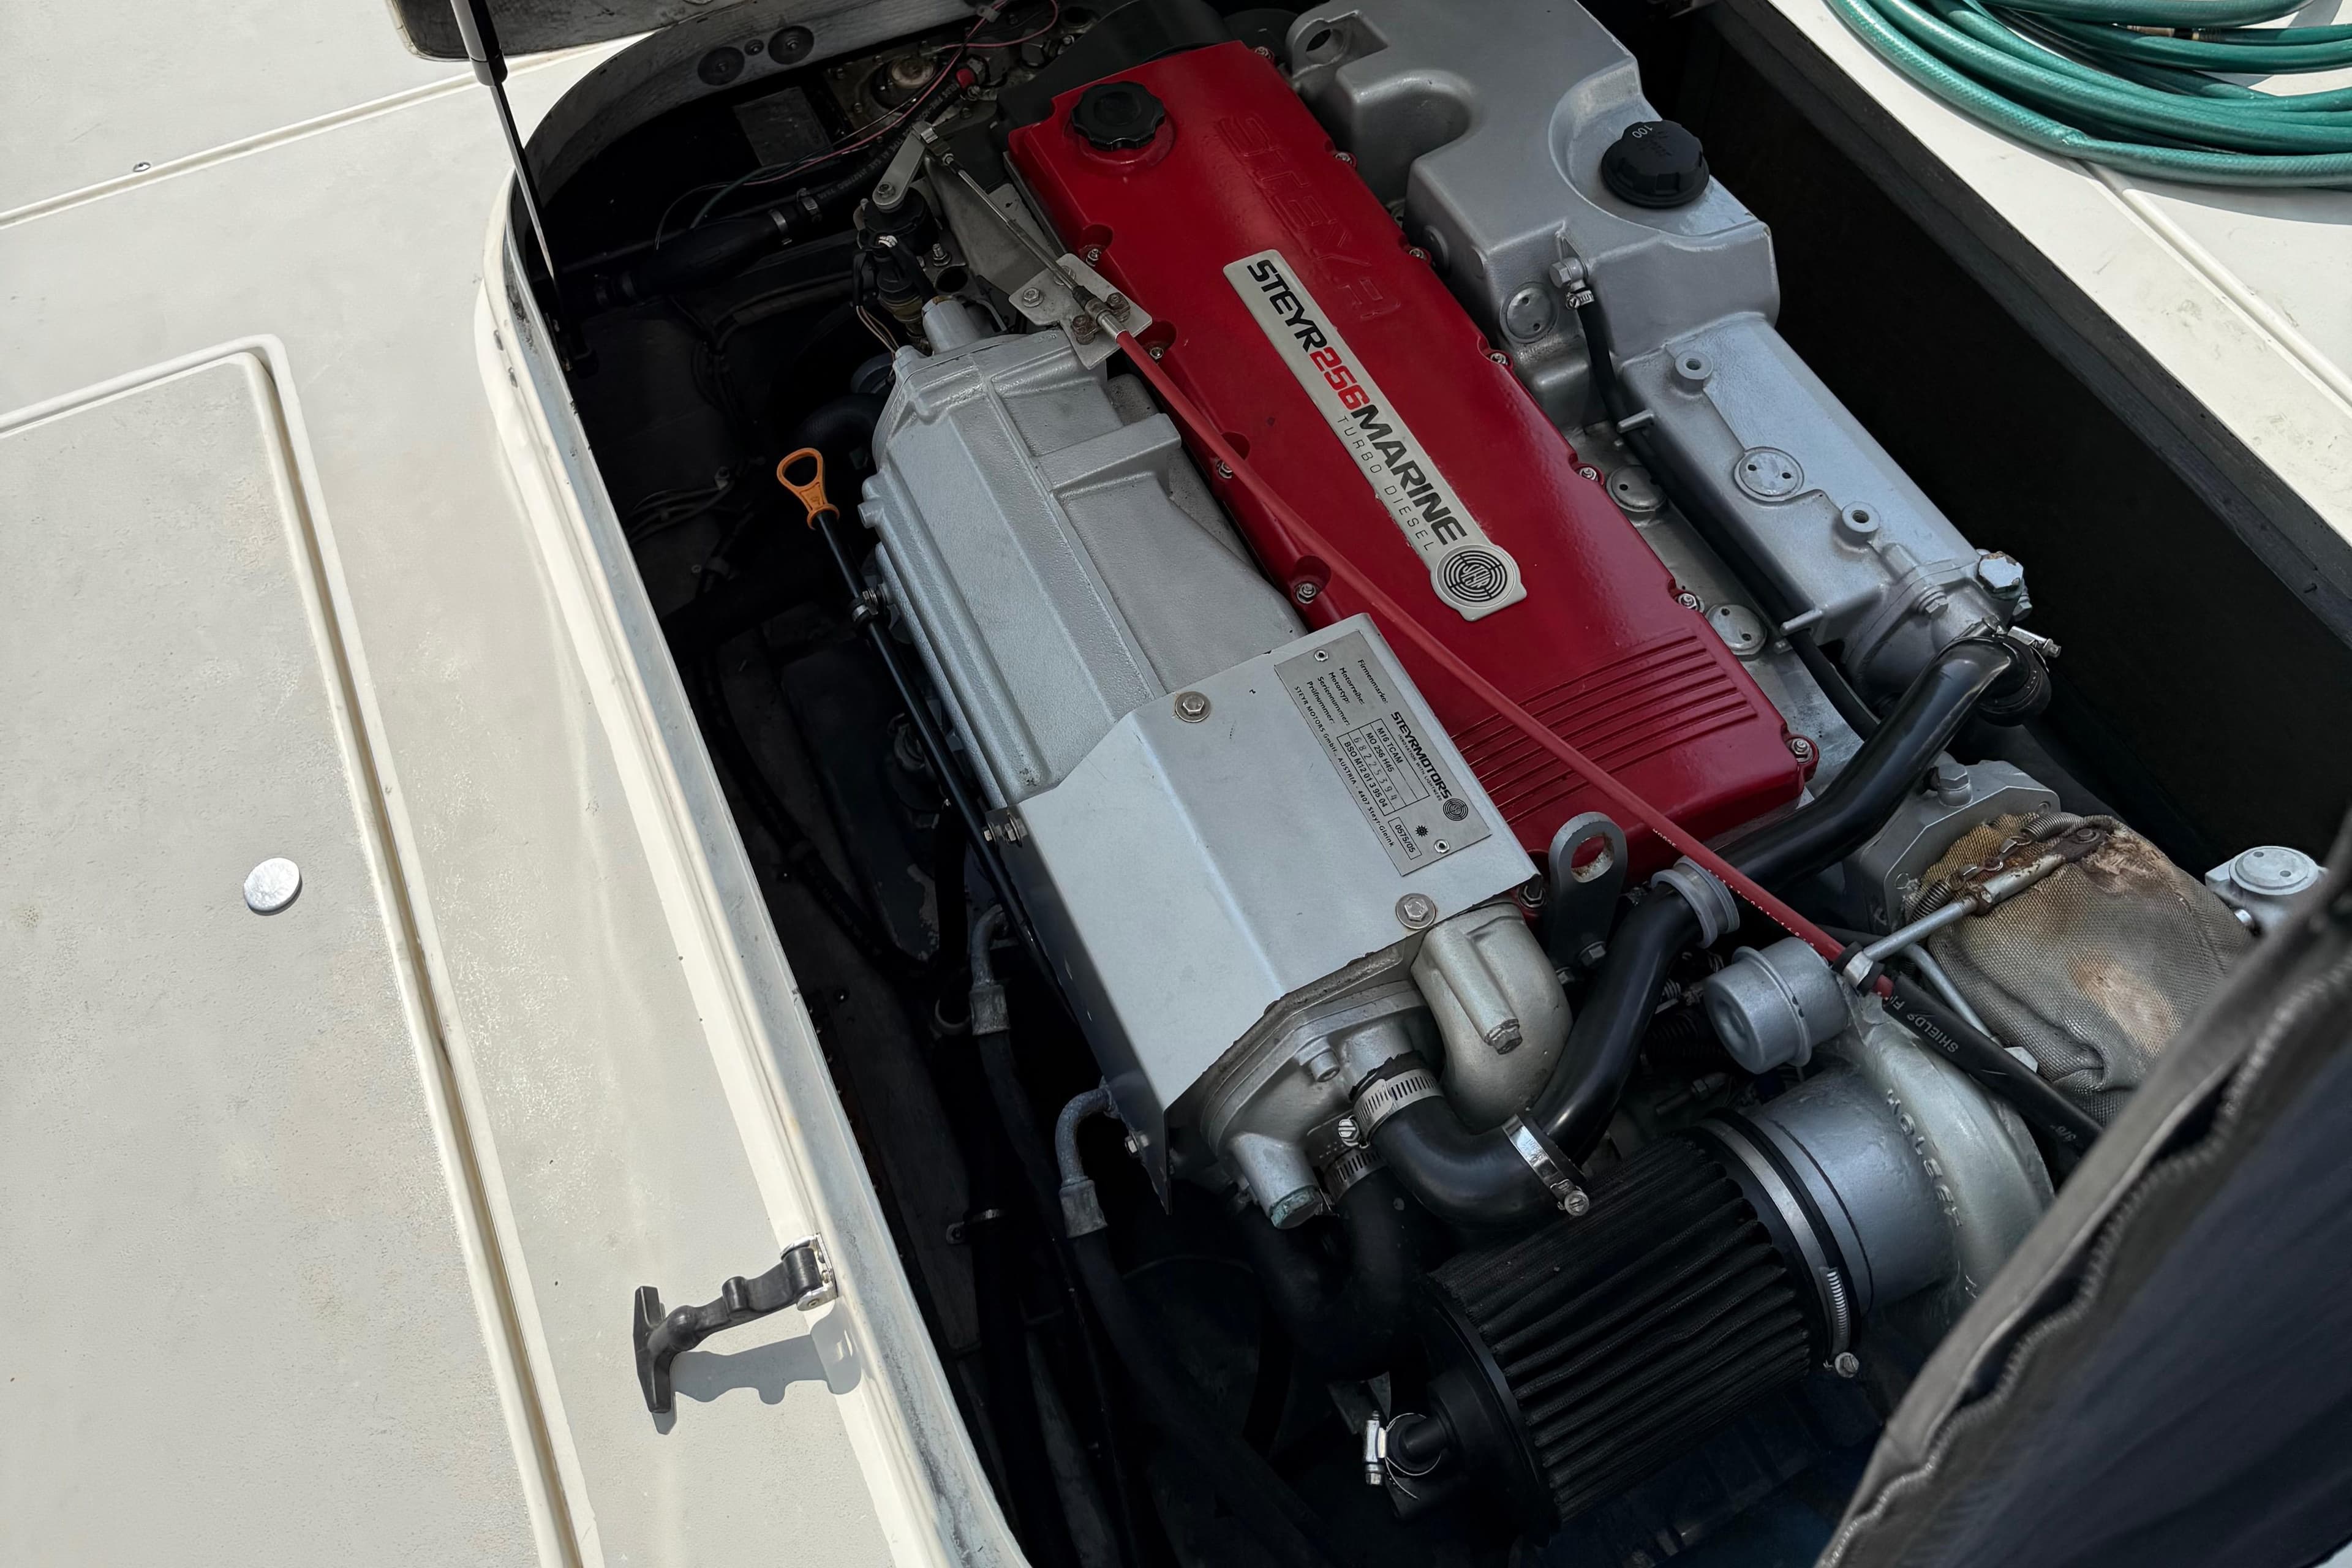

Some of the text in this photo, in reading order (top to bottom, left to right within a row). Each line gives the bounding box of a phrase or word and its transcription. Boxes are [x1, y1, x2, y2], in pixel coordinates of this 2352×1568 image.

[1632, 124, 1653, 139] 100
[1337, 415, 1436, 551] TURBO DIESEL
[1294, 686, 1308, 704] STEYR
[1306, 706, 1325, 732] MOTORS
[1338, 758, 1356, 784] AUSTRIA
[1328, 671, 1394, 772] Motortyp: MO 256 H45
[1376, 727, 1389, 742] M16
[1387, 742, 1403, 763] TCAM
[1390, 711, 1452, 799] STEYRMOTORS
[1354, 758, 1366, 773] M12
[1378, 798, 1387, 807] 04
[1395, 824, 1415, 853] 0575/05
